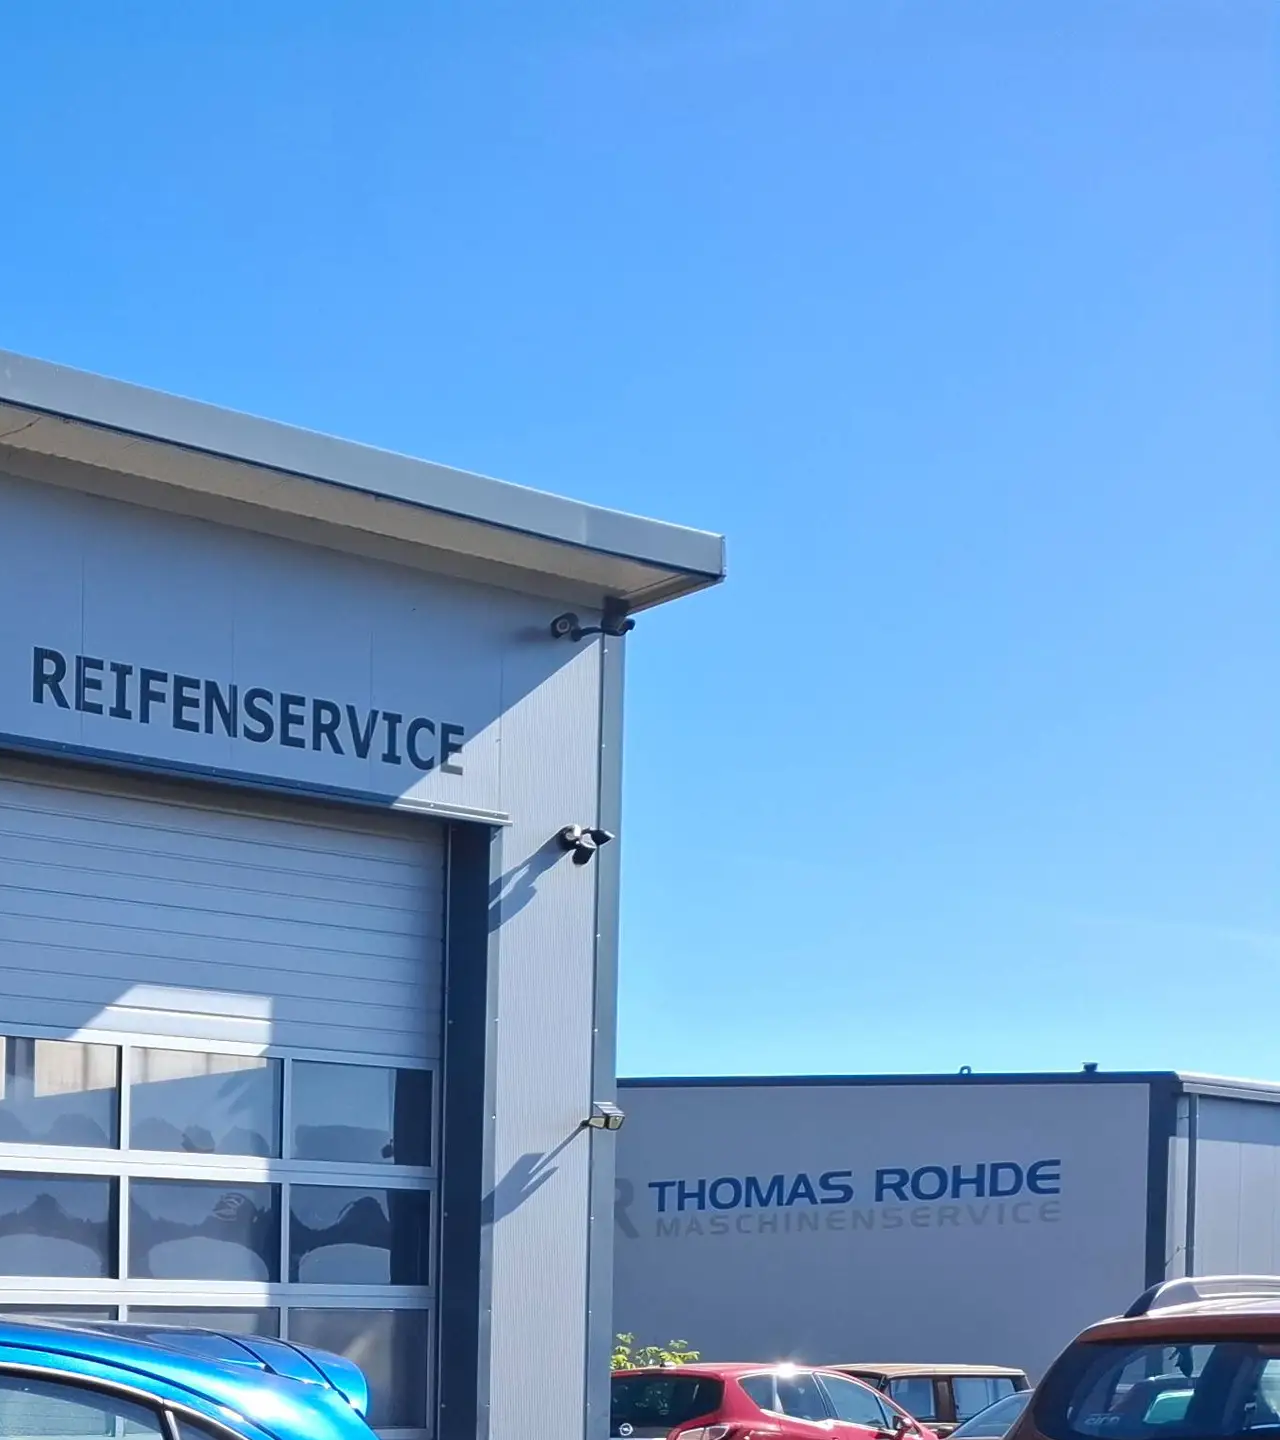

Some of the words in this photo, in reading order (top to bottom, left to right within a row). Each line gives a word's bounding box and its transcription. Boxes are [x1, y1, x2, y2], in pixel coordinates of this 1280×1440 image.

[31, 645, 465, 776] REIFENSERVICE
[648, 1170, 854, 1212] THOMAS
[874, 1159, 1061, 1203] ROHDE
[654, 1200, 1062, 1239] MASCHINENSERVICE
